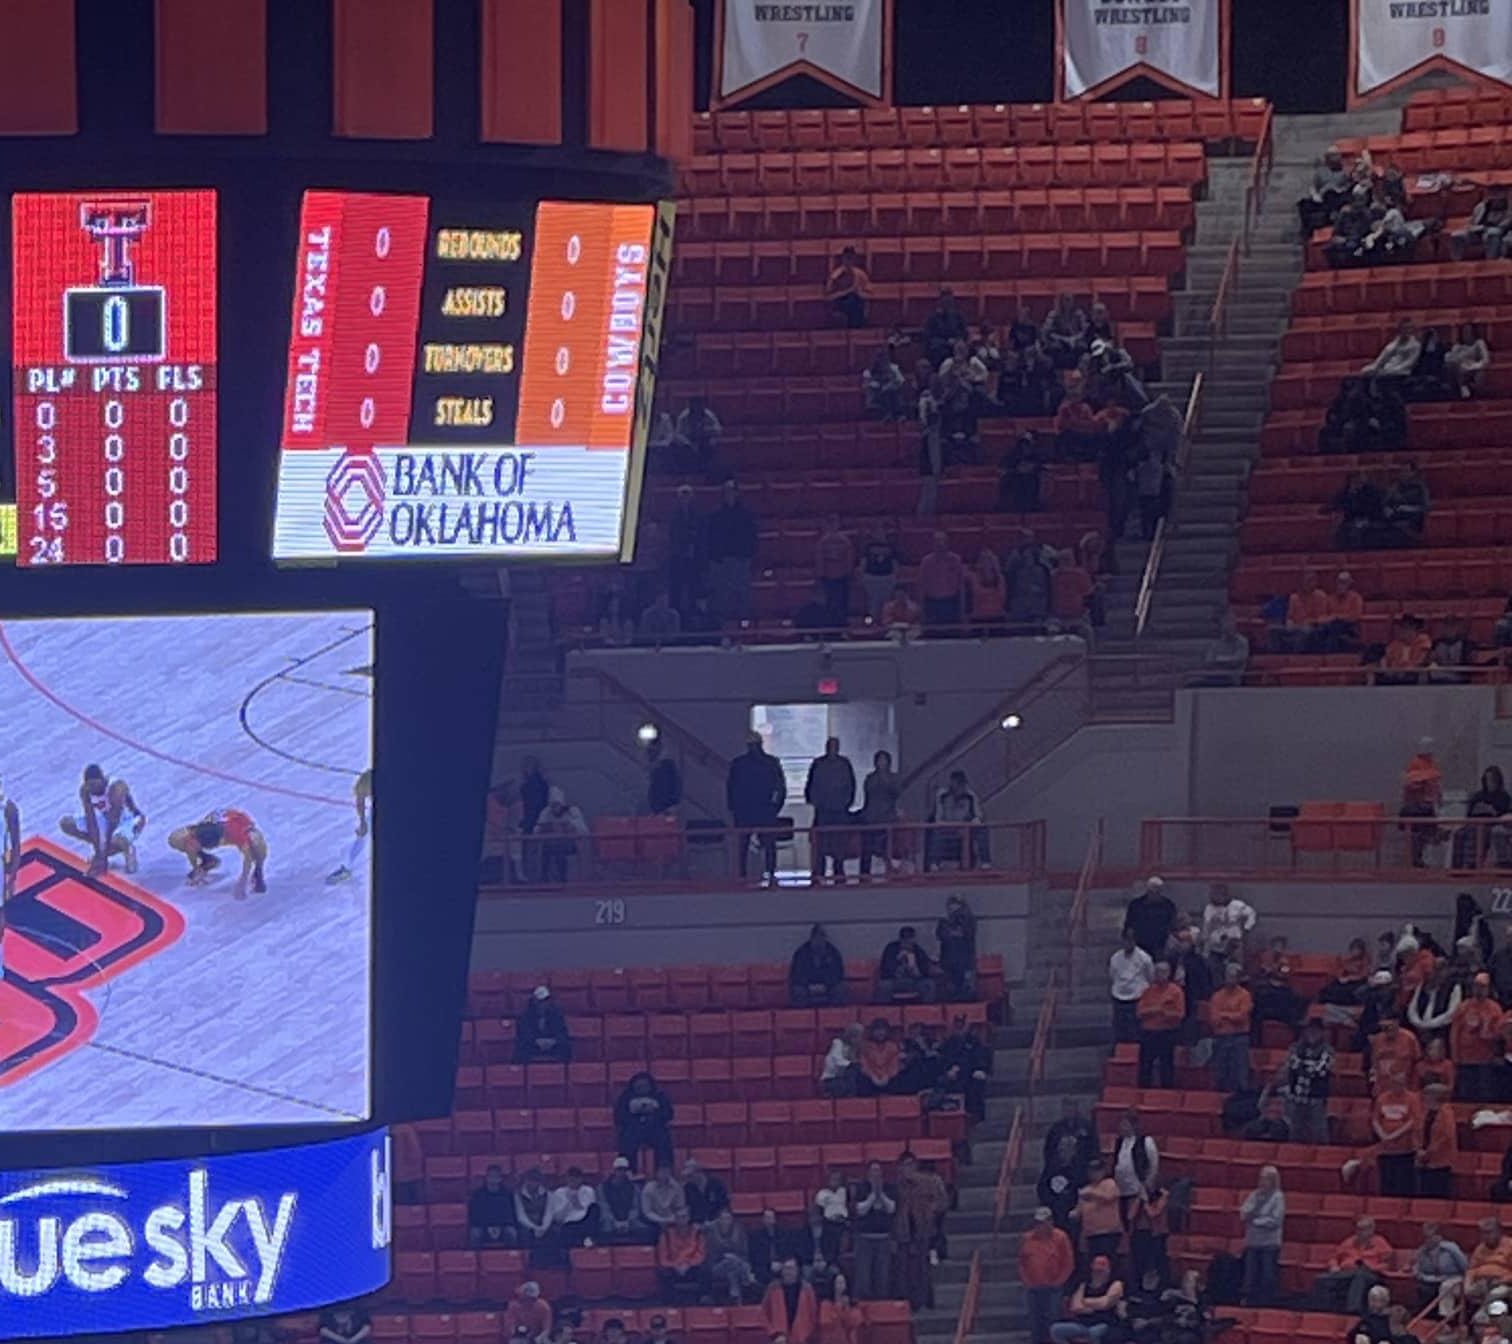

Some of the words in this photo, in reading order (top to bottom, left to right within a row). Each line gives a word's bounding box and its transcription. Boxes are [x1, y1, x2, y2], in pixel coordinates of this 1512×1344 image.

[754, 5, 854, 21] WRESTLING
[1094, 8, 1190, 24] WRESTLING
[375, 226, 391, 259] 0
[437, 227, 521, 261] REBOUNDS
[566, 234, 581, 265] 0
[301, 225, 332, 337] TEXAS
[370, 285, 385, 317] 0
[441, 287, 506, 317] ASSISTS
[561, 290, 576, 321] 0
[104, 296, 129, 351] 0
[601, 243, 645, 415] COWBOYS
[364, 342, 380, 374] 0
[424, 343, 514, 374] TURNOVERS
[555, 346, 570, 376] 0
[29, 369, 75, 393] PL#
[93, 368, 140, 392] PTS
[158, 366, 202, 390] FLS
[292, 348, 321, 433] TECH
[37, 401, 55, 428] 0
[105, 401, 123, 428] 0
[170, 400, 187, 426] 0
[360, 397, 375, 429] 0
[434, 395, 494, 427] STEALS
[550, 398, 565, 429] 0
[37, 436, 55, 462] 3
[105, 435, 123, 461] 0
[170, 434, 187, 461] 0
[38, 470, 55, 497] 5
[105, 469, 123, 495] 0
[170, 468, 187, 494] 0
[392, 453, 486, 496] BANK
[494, 451, 536, 495] OF
[34, 504, 68, 530] 15
[105, 502, 123, 529] 0
[170, 501, 187, 528] 0
[389, 501, 577, 546] OKLAHOMA
[30, 538, 65, 564] 24
[106, 536, 123, 563] 0
[170, 535, 187, 562] 0
[190, 1284, 250, 1311] BANK
